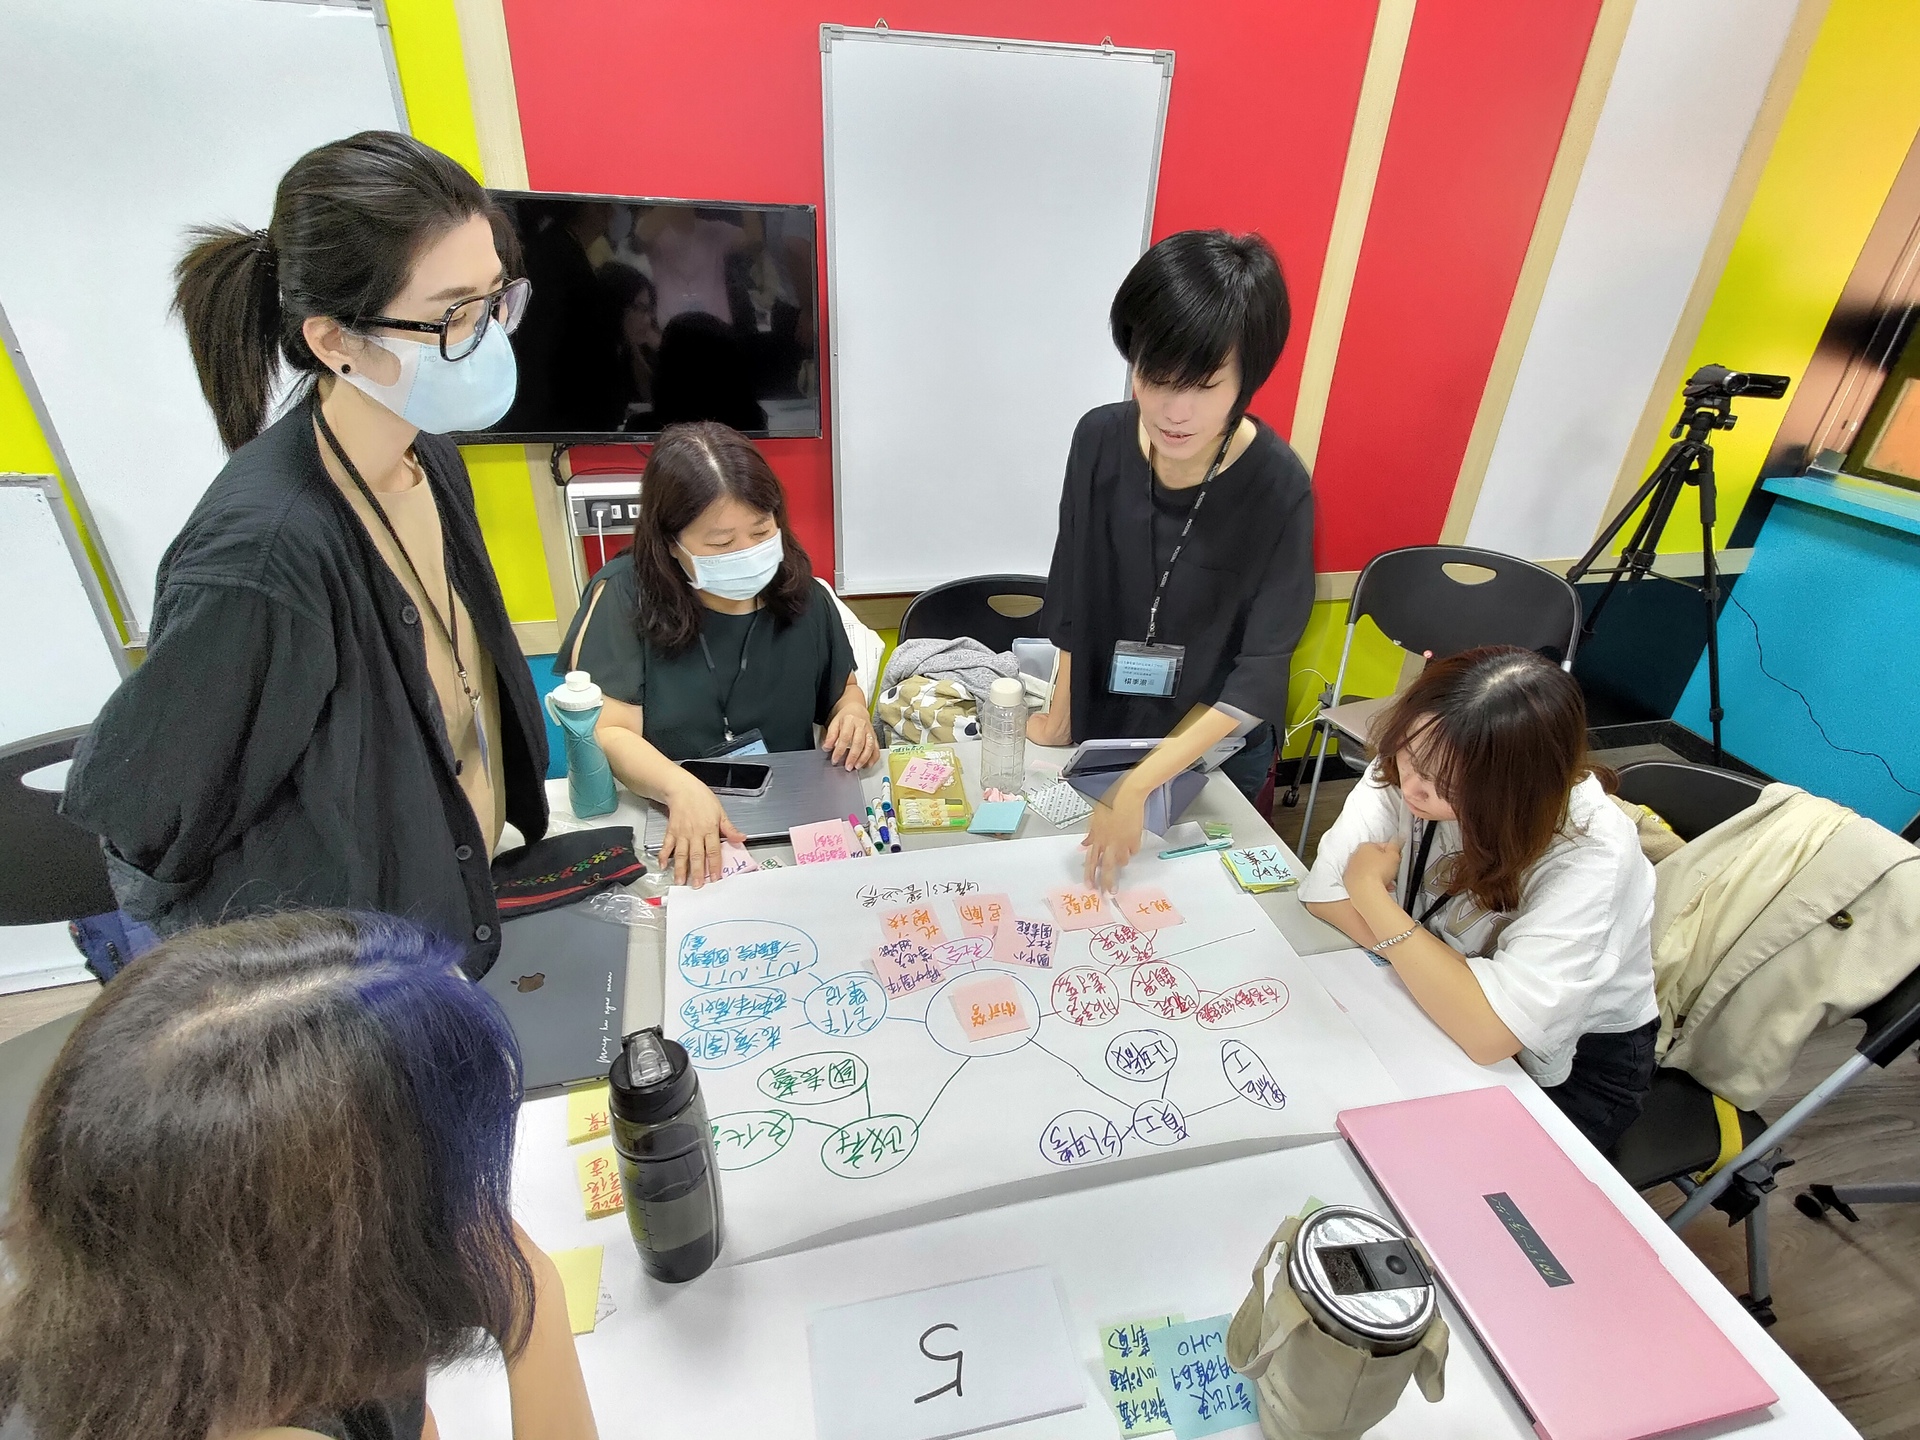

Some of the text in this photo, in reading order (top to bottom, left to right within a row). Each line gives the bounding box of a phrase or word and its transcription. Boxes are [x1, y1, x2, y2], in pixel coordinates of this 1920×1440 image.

[818, 981, 868, 1007] 單位
[821, 1006, 871, 1035] 合作
[769, 1059, 855, 1098] 國表藝
[1135, 1103, 1189, 1141] 員工
[836, 1125, 904, 1169] 政府
[1049, 1121, 1116, 1163] 外聘
[1177, 1332, 1222, 1356] WHO
[913, 1323, 963, 1404] 5
